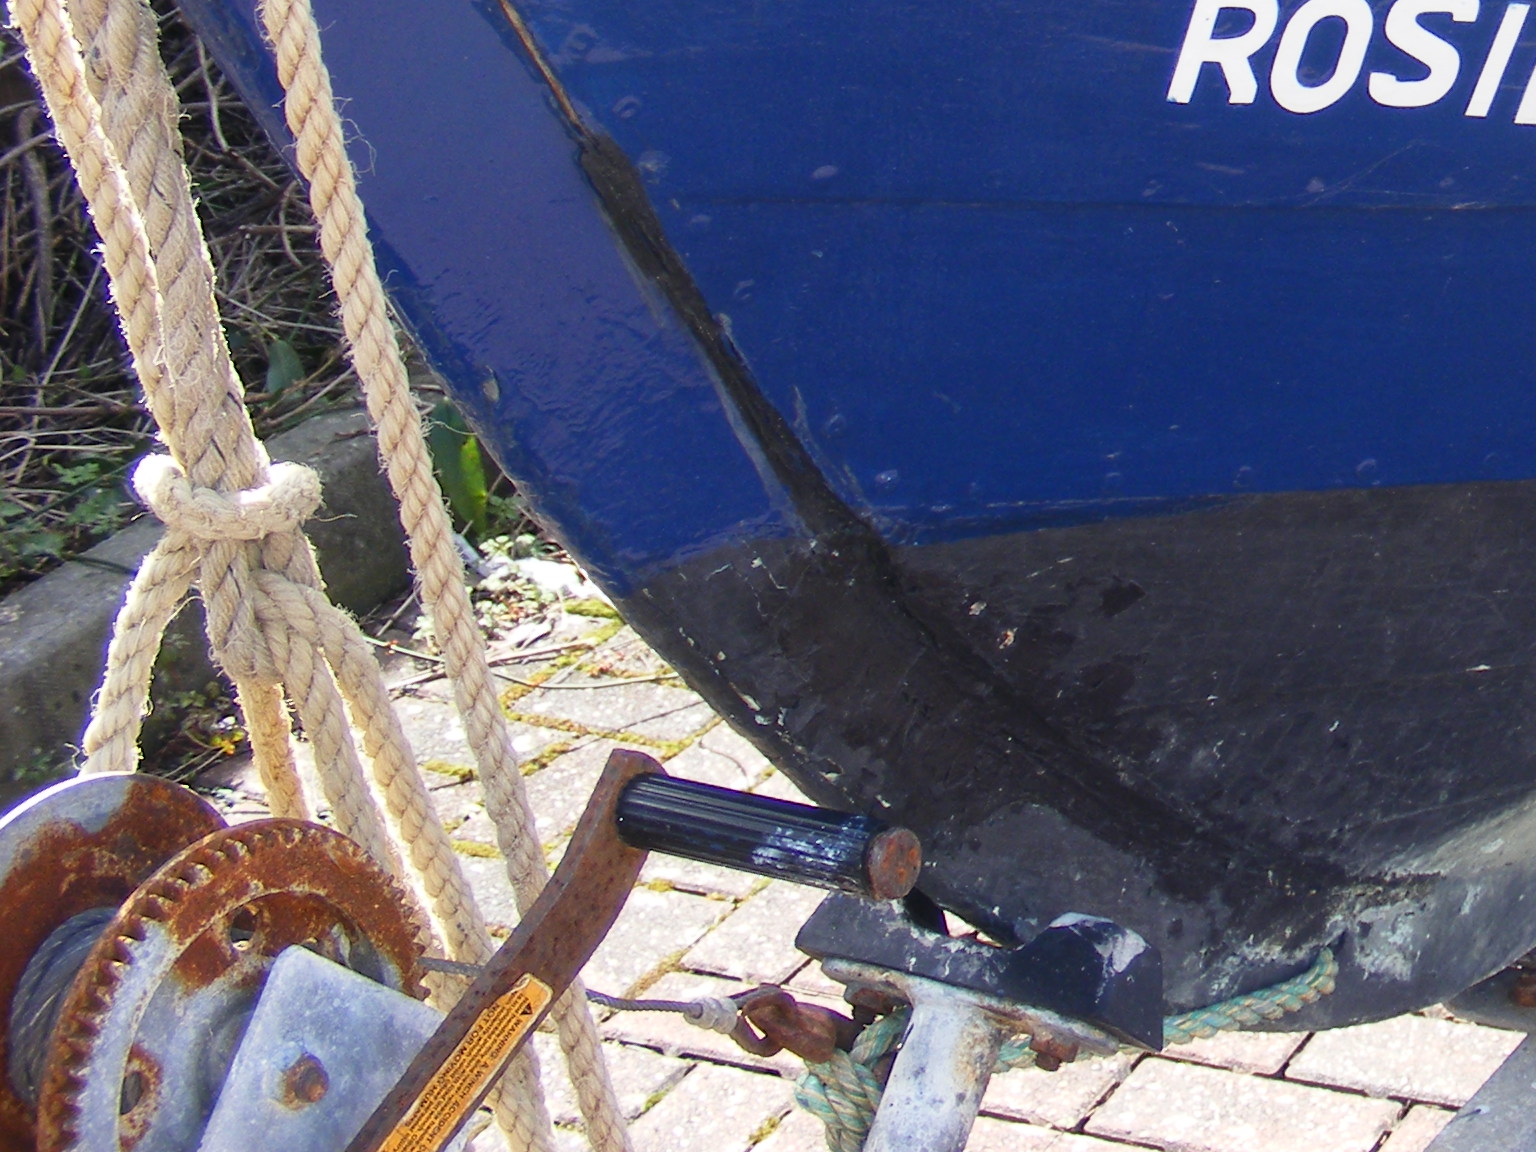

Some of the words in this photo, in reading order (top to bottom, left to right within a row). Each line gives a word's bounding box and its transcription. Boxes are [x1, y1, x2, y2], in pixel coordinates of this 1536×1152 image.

[480, 1001, 501, 1025] NOT
[464, 1023, 484, 1046] FOR
[435, 1045, 468, 1085] MOVING
[457, 1068, 484, 1100] WINCH
[424, 1099, 461, 1143] ACCIDENT
